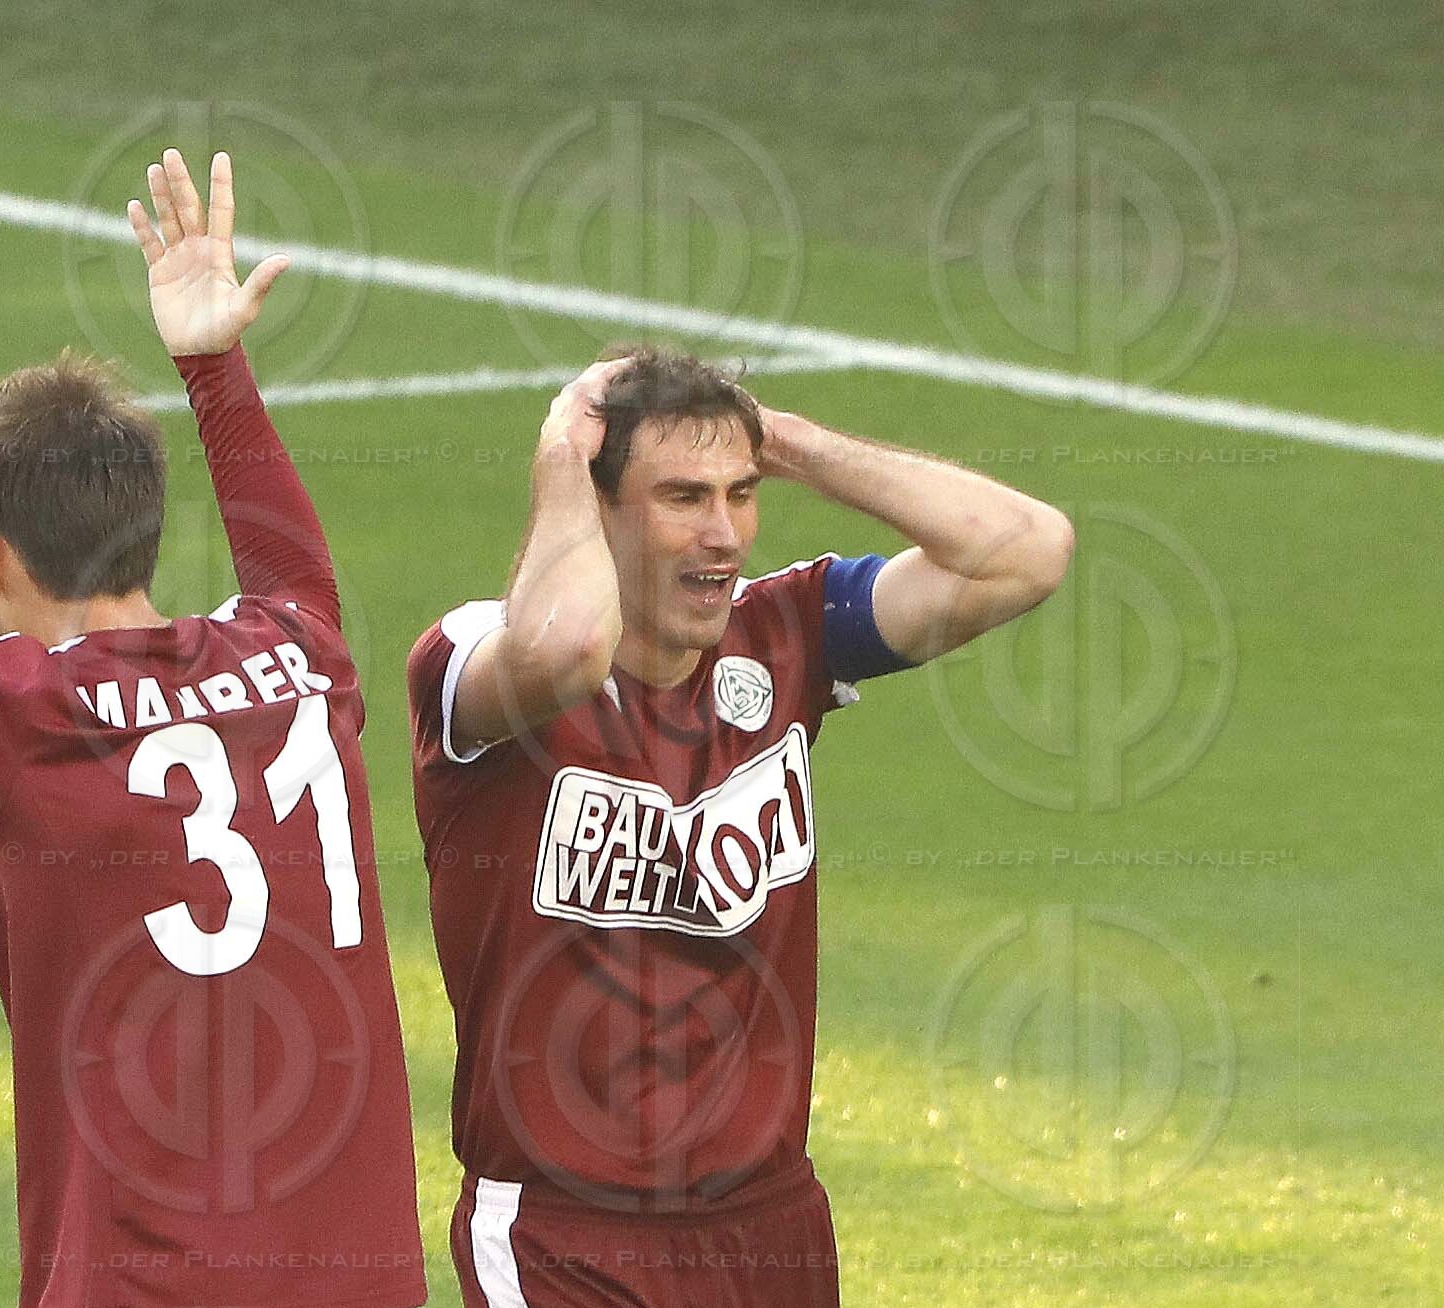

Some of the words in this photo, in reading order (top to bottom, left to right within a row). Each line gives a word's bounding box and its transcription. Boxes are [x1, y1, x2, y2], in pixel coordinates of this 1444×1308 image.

[127, 693, 363, 977] 31
[573, 791, 671, 860] BAU
[556, 843, 677, 913] WELT
